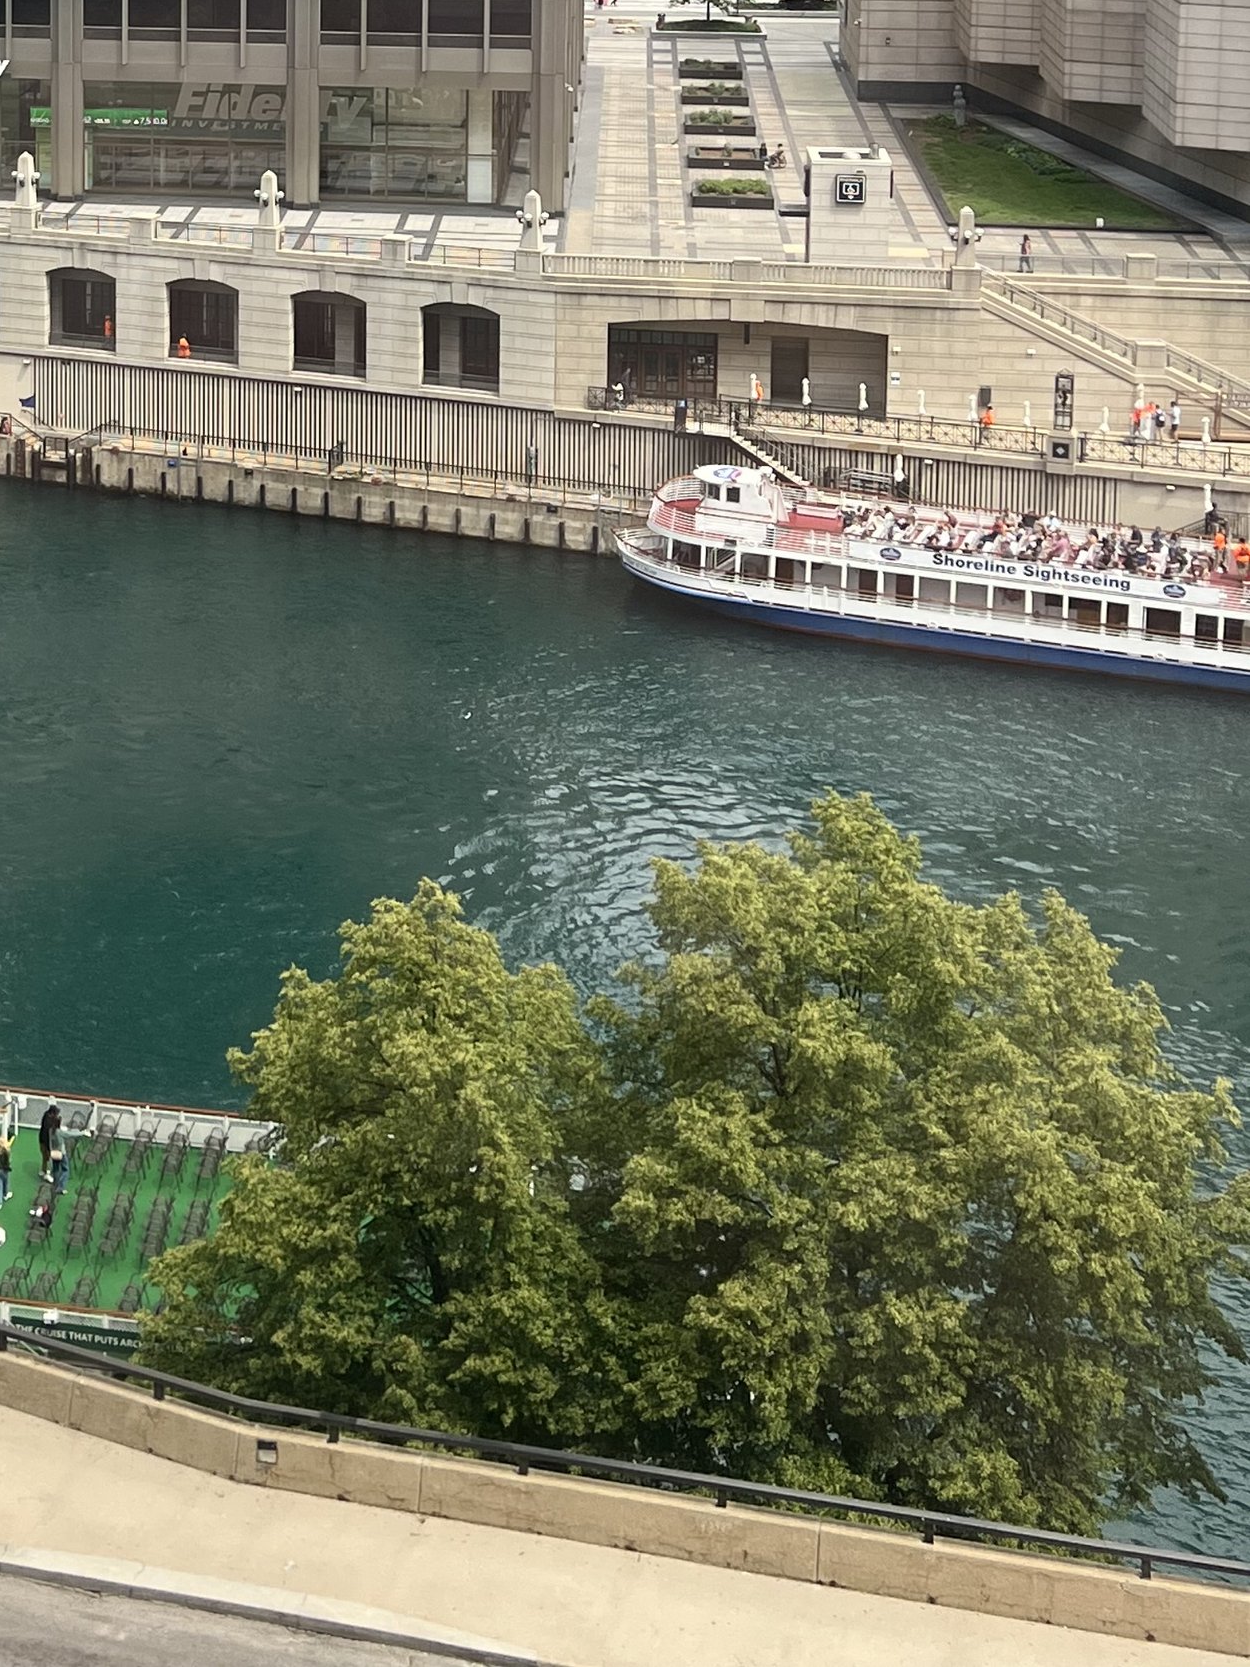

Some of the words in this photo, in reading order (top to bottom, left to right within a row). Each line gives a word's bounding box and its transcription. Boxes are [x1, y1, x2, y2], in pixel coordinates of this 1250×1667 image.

[932, 553, 1017, 575] Shoreline
[1023, 564, 1131, 592] Sightseeing
[15, 1324, 34, 1333] THE
[68, 1331, 93, 1343] THAT
[94, 1334, 119, 1346] PUTS
